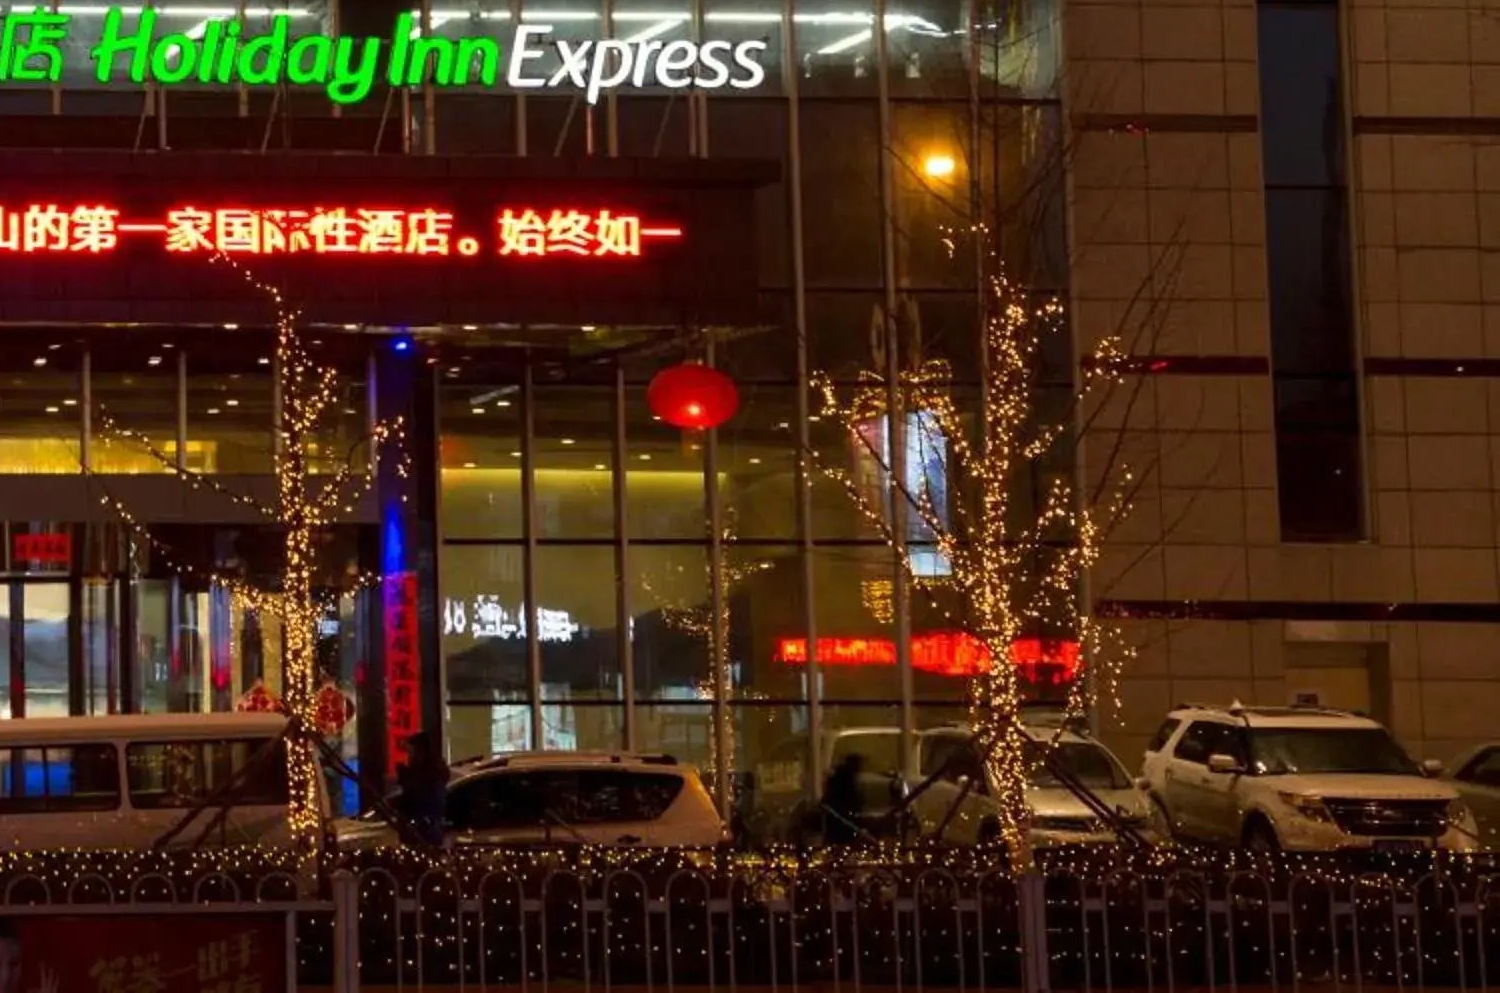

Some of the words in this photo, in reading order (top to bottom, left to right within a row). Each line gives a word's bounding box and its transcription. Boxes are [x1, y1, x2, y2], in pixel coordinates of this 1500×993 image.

[91, 6, 381, 103] Holiday
[388, 12, 499, 86] Inn
[507, 24, 767, 104] Express
